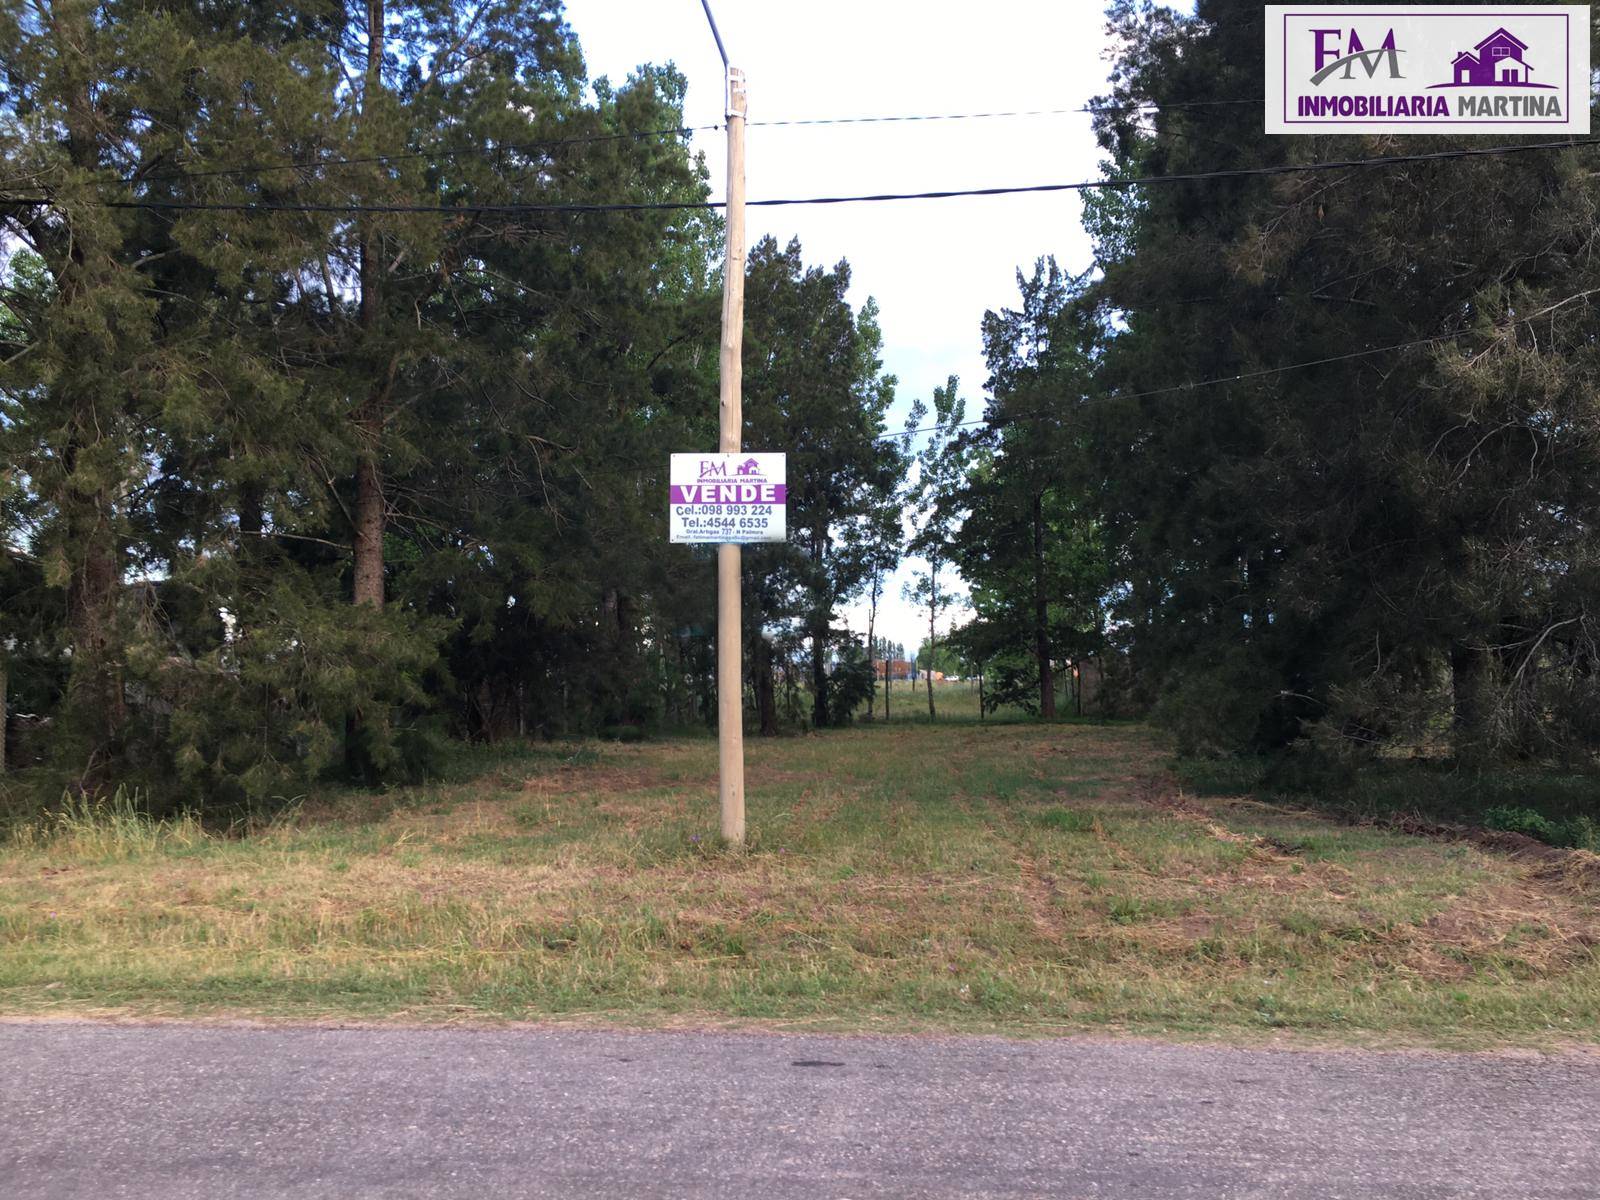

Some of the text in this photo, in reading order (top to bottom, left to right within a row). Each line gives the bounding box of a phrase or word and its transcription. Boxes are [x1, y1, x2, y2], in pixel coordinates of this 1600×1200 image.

[680, 485, 776, 503] VENDE
[675, 504, 773, 516] Cel.:098 993 224
[681, 517, 769, 529] Tel.:4544 6535
